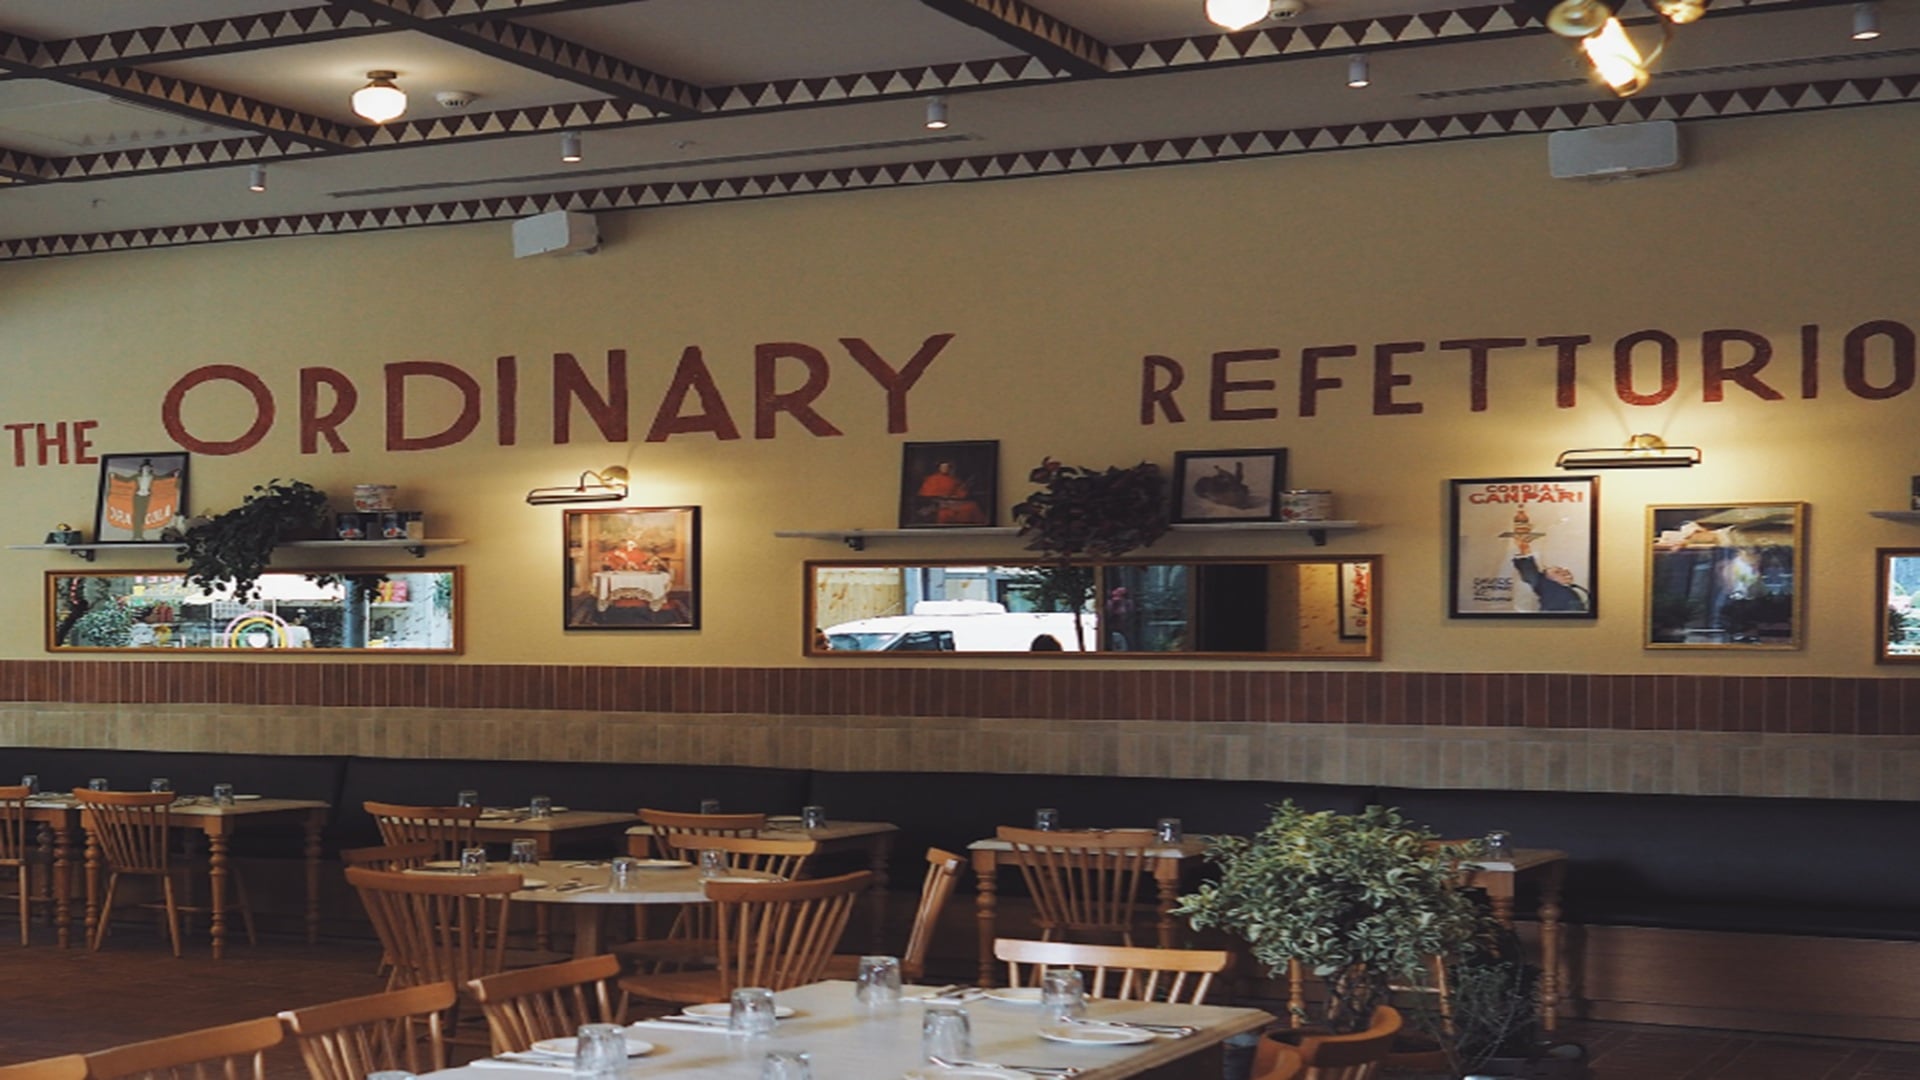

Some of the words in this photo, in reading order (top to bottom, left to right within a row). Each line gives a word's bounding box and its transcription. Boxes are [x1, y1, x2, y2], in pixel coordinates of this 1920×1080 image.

[5, 420, 98, 467] THE
[162, 333, 955, 456] ORDINARY
[1141, 319, 1916, 425] REFETTORIO
[1485, 484, 1566, 492] CORDIAL
